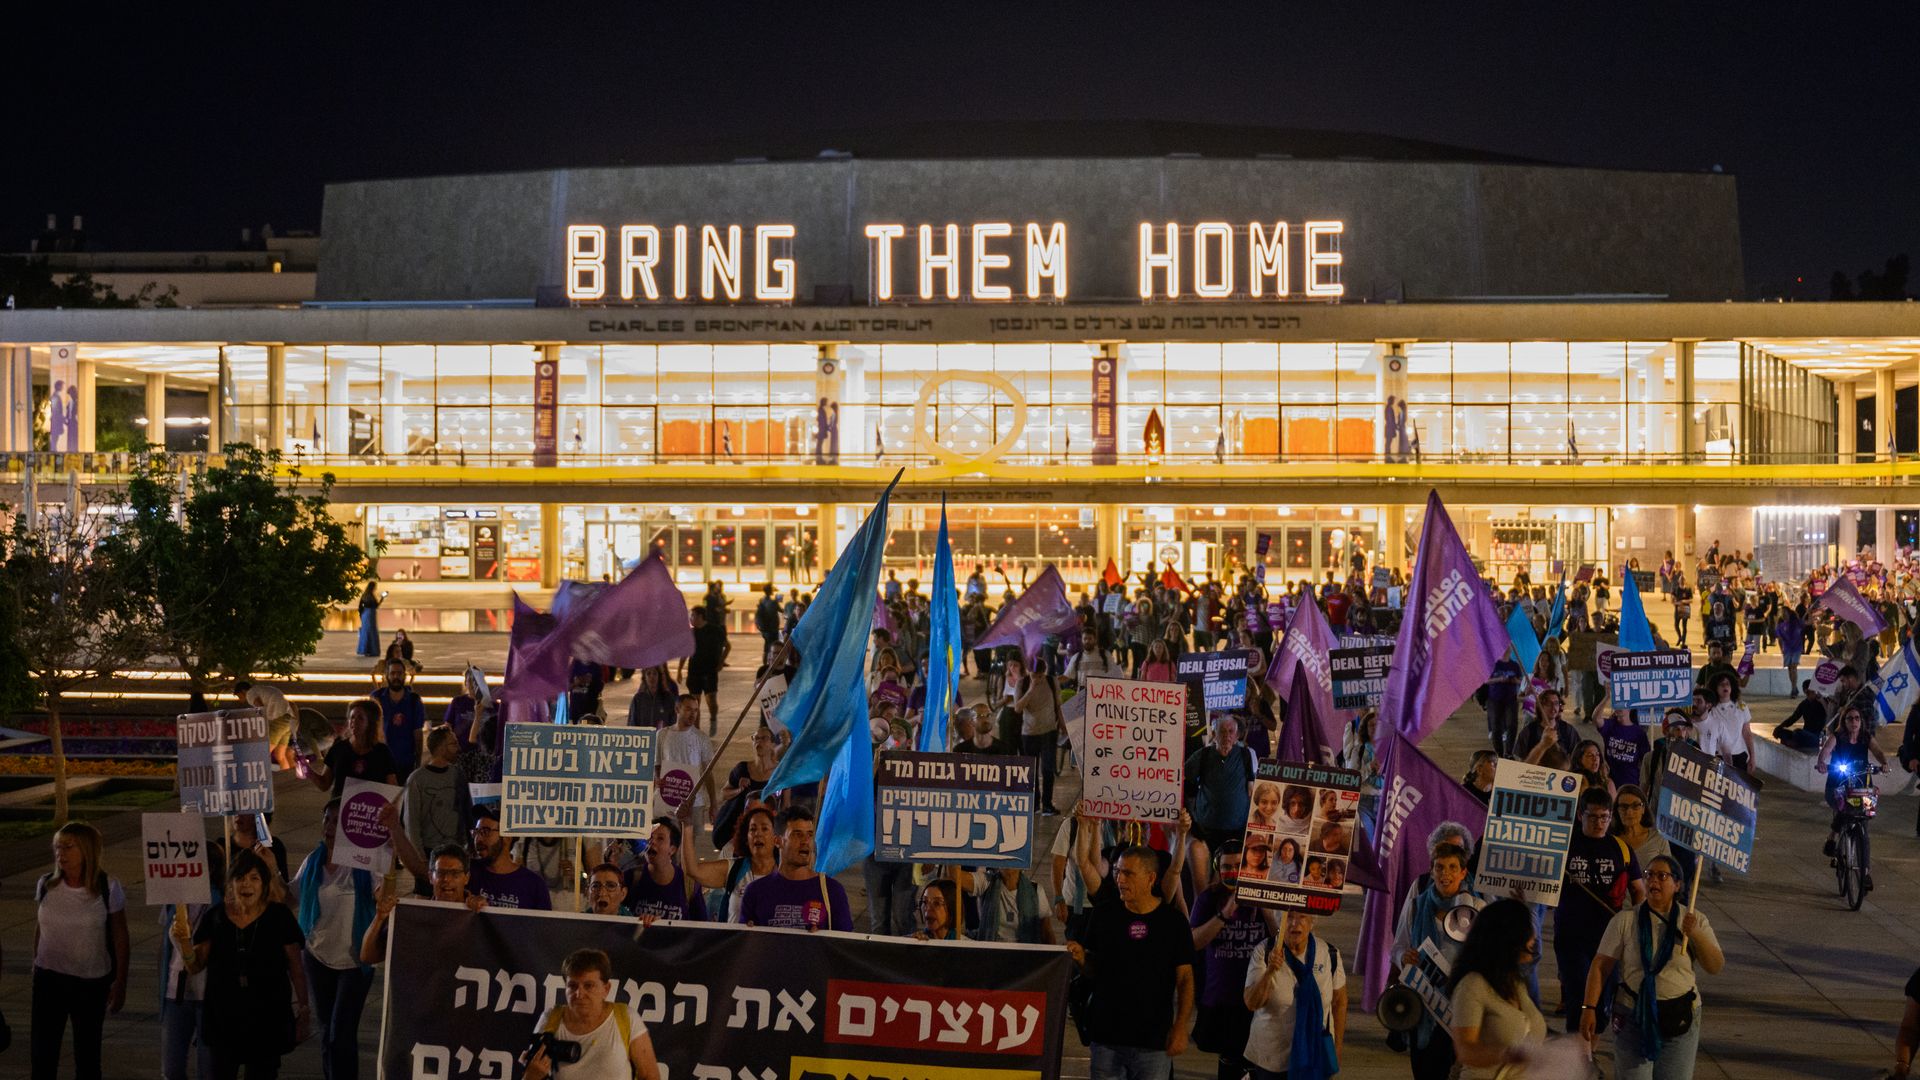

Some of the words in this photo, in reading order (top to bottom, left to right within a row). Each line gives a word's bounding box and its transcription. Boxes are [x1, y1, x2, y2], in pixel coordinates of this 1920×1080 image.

[566, 224, 796, 300] BRING
[865, 222, 1067, 300] THEM
[1139, 221, 1344, 298] HOME
[589, 320, 684, 332] CHARLES
[695, 319, 805, 332] BRONFMAN
[812, 319, 933, 332] AUDITORIUM
[1171, 316, 1248, 330] התרבות
[1253, 315, 1301, 330] היכל
[1179, 661, 1204, 674] DEAL
[1206, 658, 1248, 672] REFUSAL
[1332, 657, 1362, 671] DEAL
[1363, 654, 1393, 669] REFU
[1613, 657, 1629, 667] מדי
[1631, 656, 1651, 667] גבוה
[1653, 655, 1674, 666] מחיר
[1676, 653, 1689, 666] אין
[1652, 670, 1665, 680] את
[1090, 683, 1125, 700] WAR
[1131, 687, 1181, 706] CRIMES
[1205, 680, 1238, 696] TAGES'
[1614, 680, 1691, 702] עכשיו!
[1335, 695, 1366, 708] DEATH
[1095, 703, 1178, 725] MINISTERS
[179, 717, 222, 747] לעסקה
[226, 717, 266, 740] סירוב
[553, 731, 599, 747] מדיניים
[1092, 723, 1127, 740] GET
[1132, 727, 1167, 743] OUT
[602, 733, 650, 748] הסכמים
[510, 747, 579, 775] בטחון
[589, 750, 649, 775] יביאו
[1095, 747, 1113, 758] OF
[1122, 745, 1169, 762] GAZA
[242, 761, 267, 783] גזר
[885, 759, 914, 778] מדי
[918, 761, 955, 780] גבוה
[961, 763, 1000, 783] מחיר
[1005, 765, 1030, 787] אין
[1110, 764, 1131, 779] GO
[1137, 767, 1181, 787] HOME!
[1258, 763, 1281, 777] CRY
[1283, 766, 1305, 780] OUT
[1306, 768, 1329, 783] FOR
[1330, 772, 1360, 787] THEM
[507, 780, 586, 801] החטופים
[1668, 752, 1701, 785] DEAL
[1704, 769, 1757, 811] REFUSAL
[590, 783, 648, 804] השבת
[882, 789, 951, 807] החטופים
[956, 793, 980, 810] את
[985, 791, 1030, 812] הצילו
[1096, 784, 1177, 806] ממשלת
[506, 804, 579, 828] הניצחון
[1084, 799, 1132, 816] מלחמה
[1135, 805, 1181, 820] פושעי
[1495, 790, 1573, 821] ביטחון
[584, 806, 646, 828] תמונת
[1669, 794, 1745, 845] HOSTAGES'
[882, 808, 1028, 853] עכשיו!
[147, 829, 199, 859] שלום
[1660, 815, 1694, 846] DEATH
[1693, 831, 1750, 873] SENTENCE
[149, 862, 203, 878] עכשיו
[1489, 848, 1555, 876] חדשה
[1237, 886, 1262, 898] BRING
[1262, 889, 1285, 901] THEM
[1285, 891, 1307, 904] HOME
[1307, 895, 1340, 911] NOW!
[454, 965, 709, 1027] המחמה
[726, 985, 817, 1034] את
[837, 991, 1041, 1051] עוצרים
